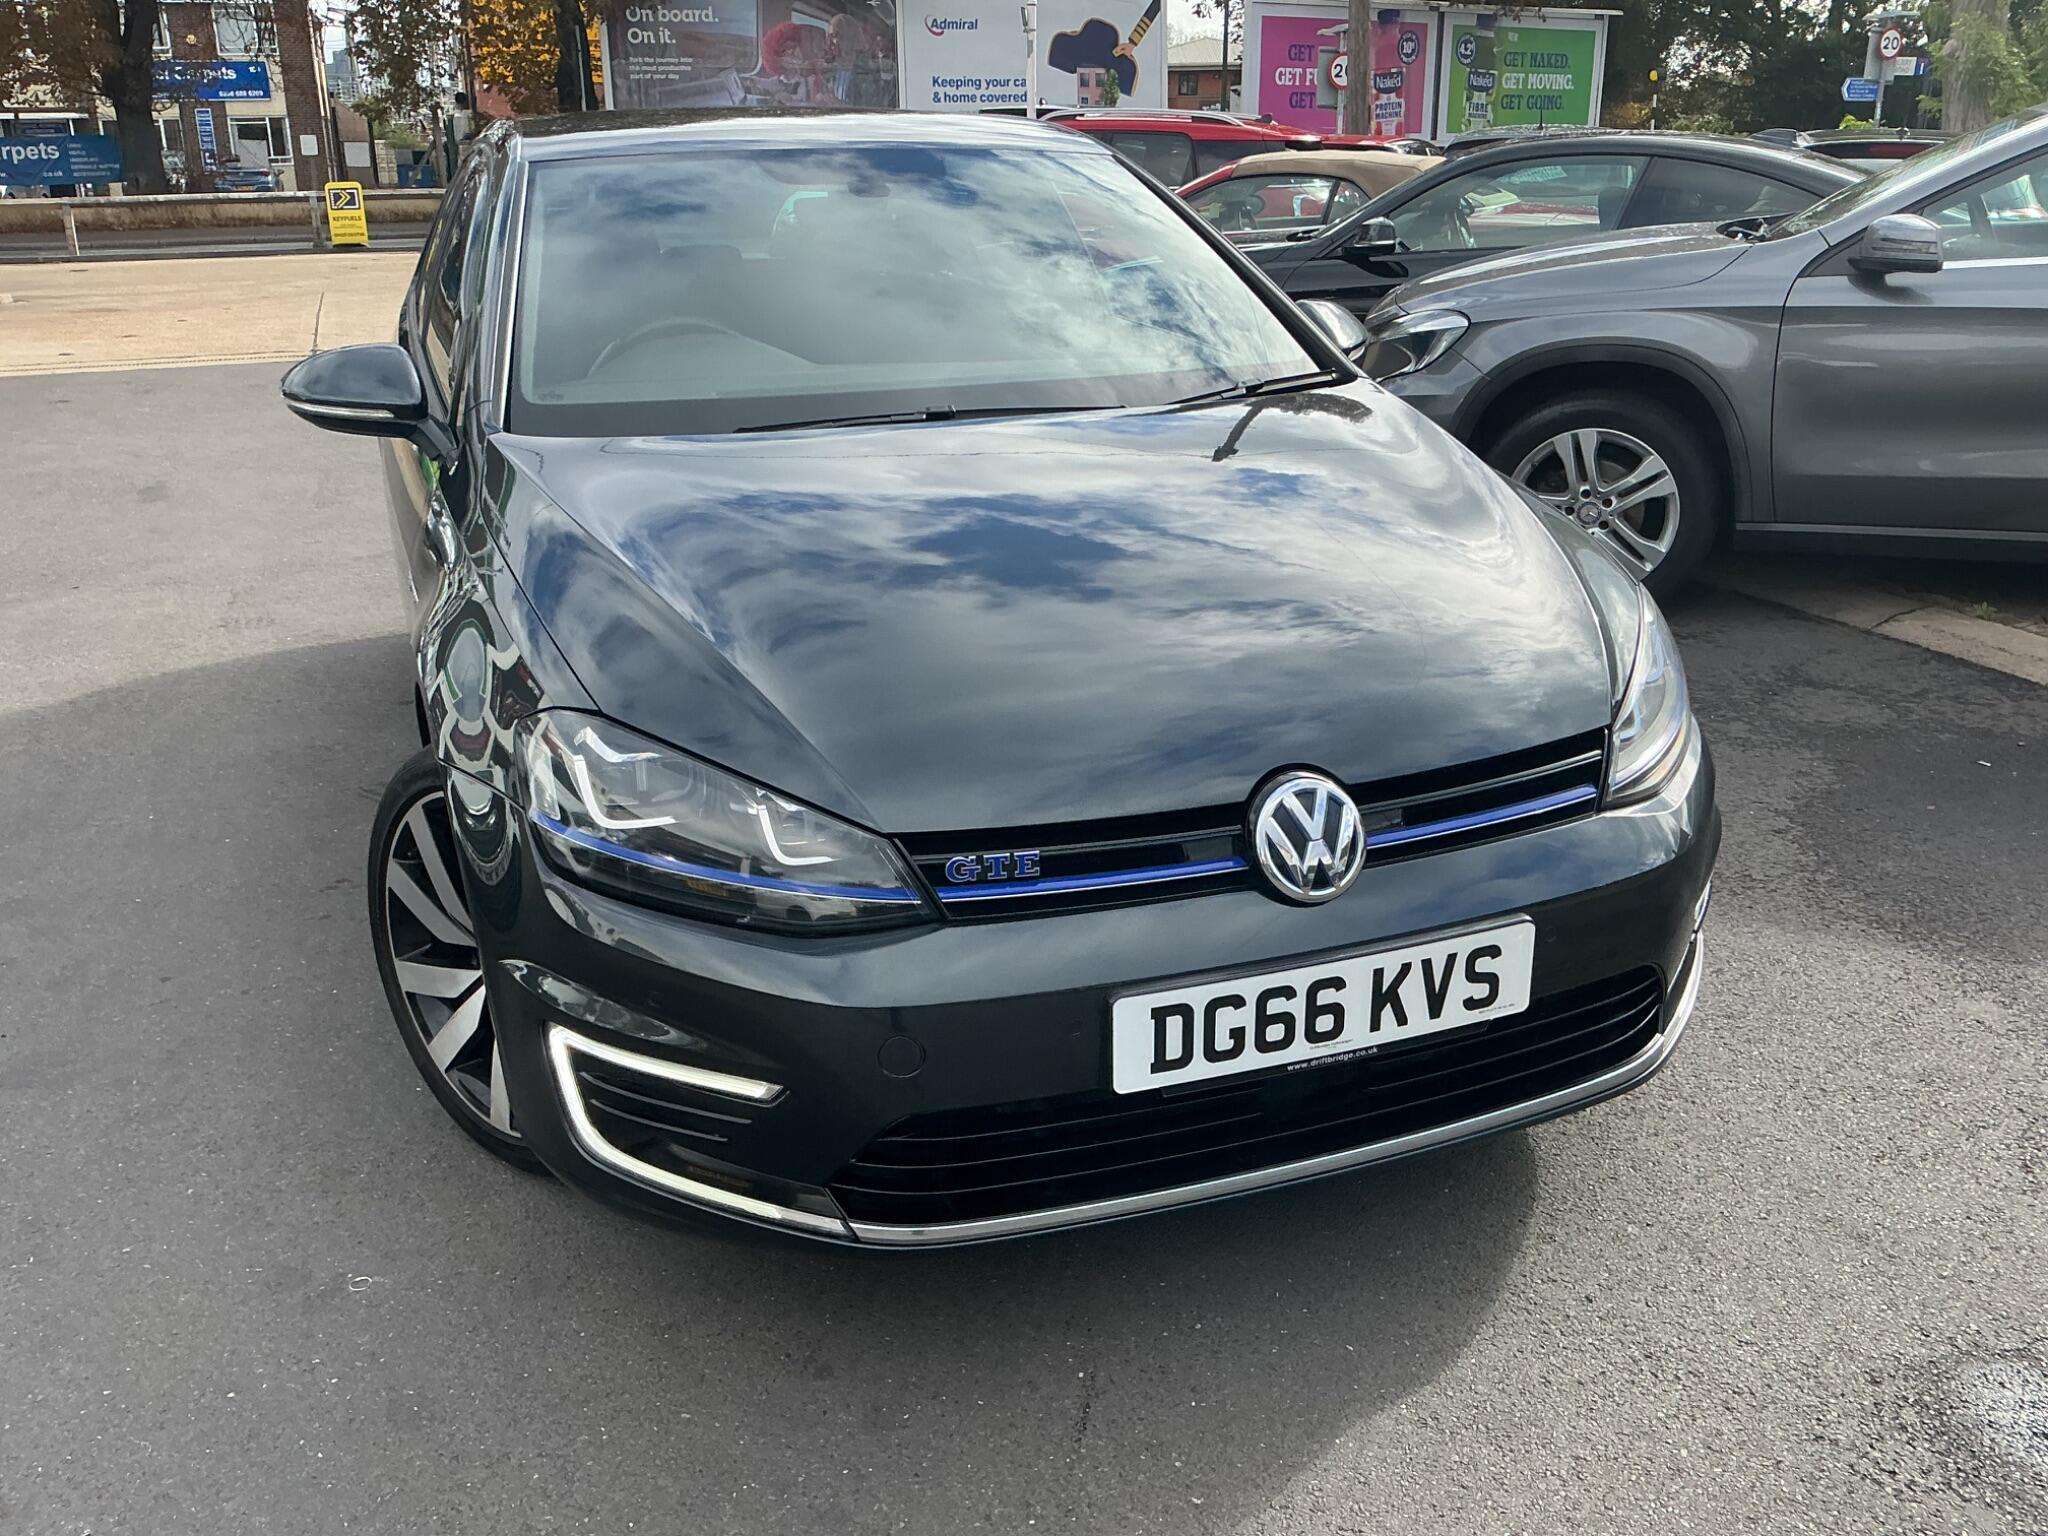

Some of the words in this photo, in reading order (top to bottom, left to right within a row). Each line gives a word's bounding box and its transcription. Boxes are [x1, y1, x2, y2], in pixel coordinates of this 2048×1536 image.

[626, 6, 654, 22] On
[657, 5, 719, 22] board.
[930, 18, 978, 30] Admiral
[627, 27, 656, 44] On
[658, 27, 677, 44] it.
[1883, 37, 1899, 50] 20
[1288, 44, 1315, 61] GET
[1504, 52, 1527, 67] GET
[1529, 52, 1571, 69] NAKED.
[1275, 67, 1303, 86] GET
[1334, 63, 1348, 78] 2
[932, 76, 982, 90] Keeping
[984, 78, 1011, 90] your
[1013, 78, 1027, 87] ca
[1376, 74, 1401, 88] Naked
[1469, 74, 1493, 87] Naked
[1502, 73, 1526, 89] GET
[1527, 74, 1574, 90] MOVING.
[932, 91, 942, 103] &
[944, 92, 977, 103] home
[980, 91, 1027, 103] covered
[1288, 92, 1316, 109] GET
[1501, 94, 1525, 110] GET
[1526, 95, 1564, 110] GOING.
[1375, 100, 1402, 112] PROTEIN
[1468, 102, 1489, 113] FIBRE
[1375, 111, 1402, 120] MACHINE
[0, 142, 60, 165] rpets
[945, 850, 1040, 883] GTE
[1150, 975, 1348, 1075] DG66
[1369, 944, 1503, 1034] KVS
[1287, 1046, 1379, 1072] www.driftbridge.co.uk
